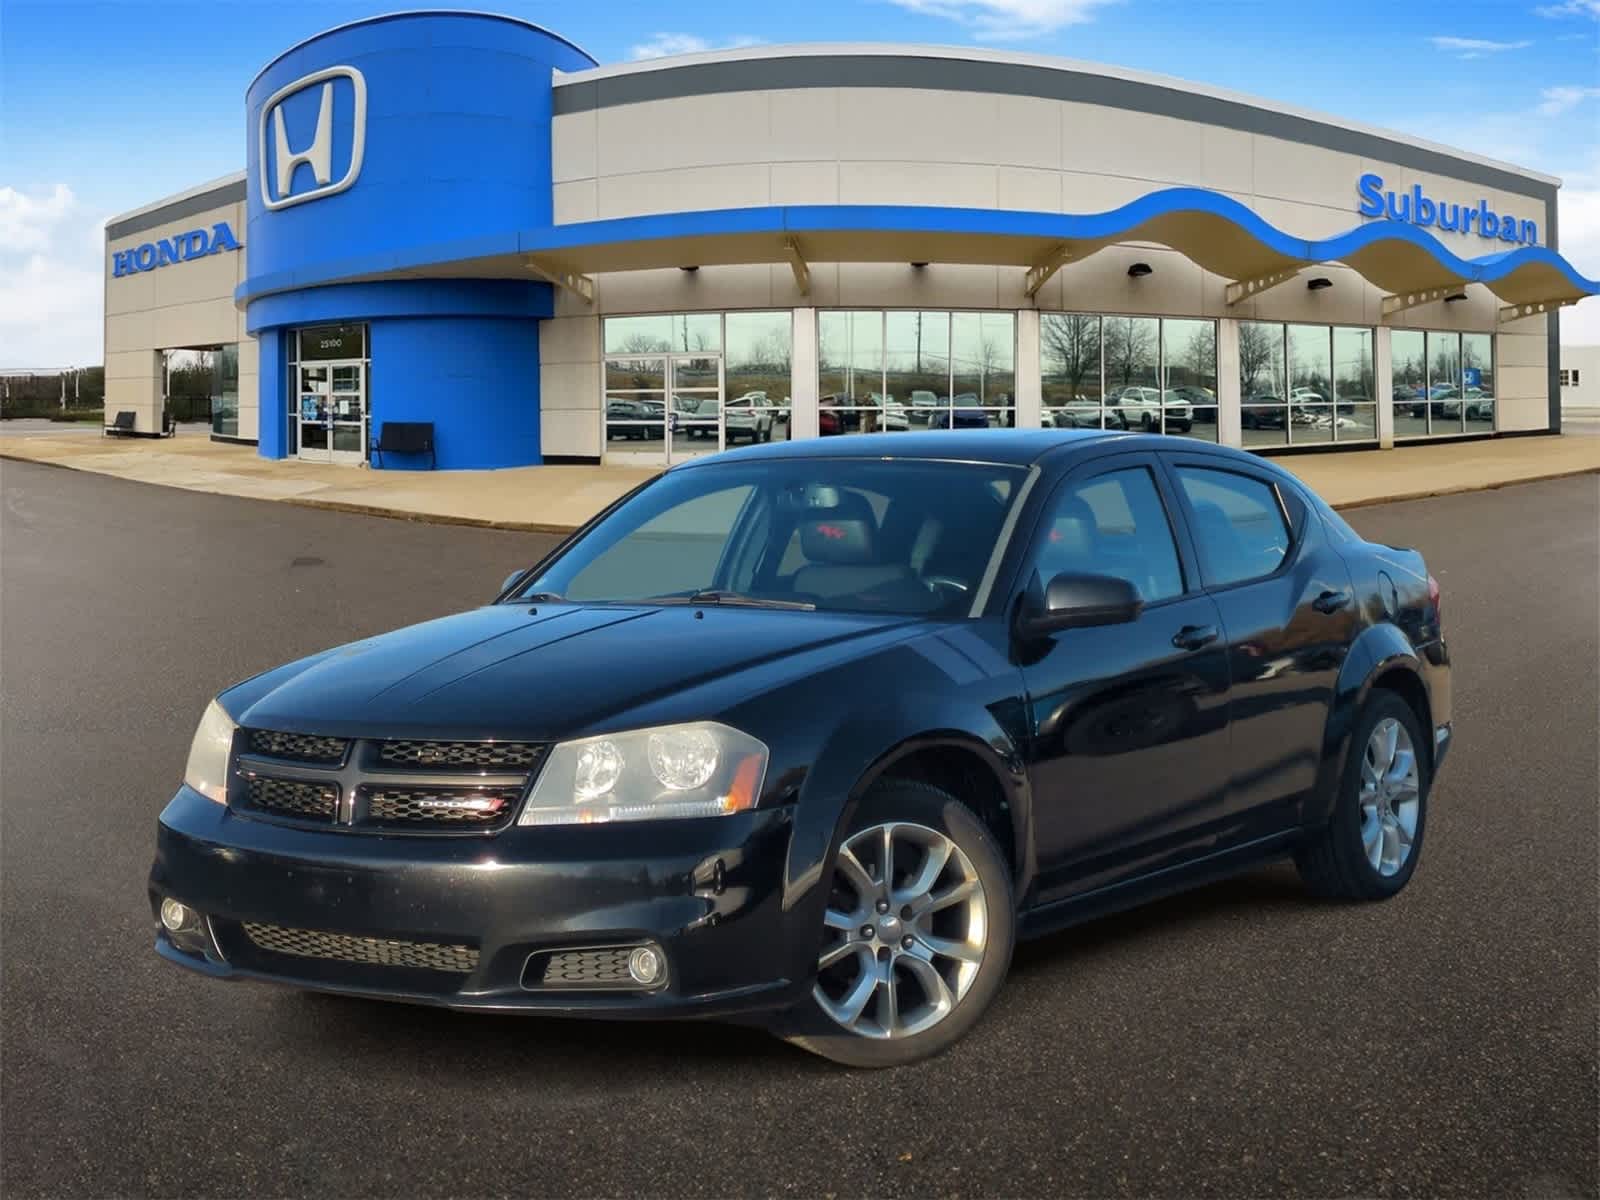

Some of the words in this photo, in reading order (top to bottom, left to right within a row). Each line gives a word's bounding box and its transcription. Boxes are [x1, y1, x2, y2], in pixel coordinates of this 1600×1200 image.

[1358, 173, 1538, 245] Suburban
[112, 221, 242, 278] HONDA
[419, 800, 485, 810] DOD
